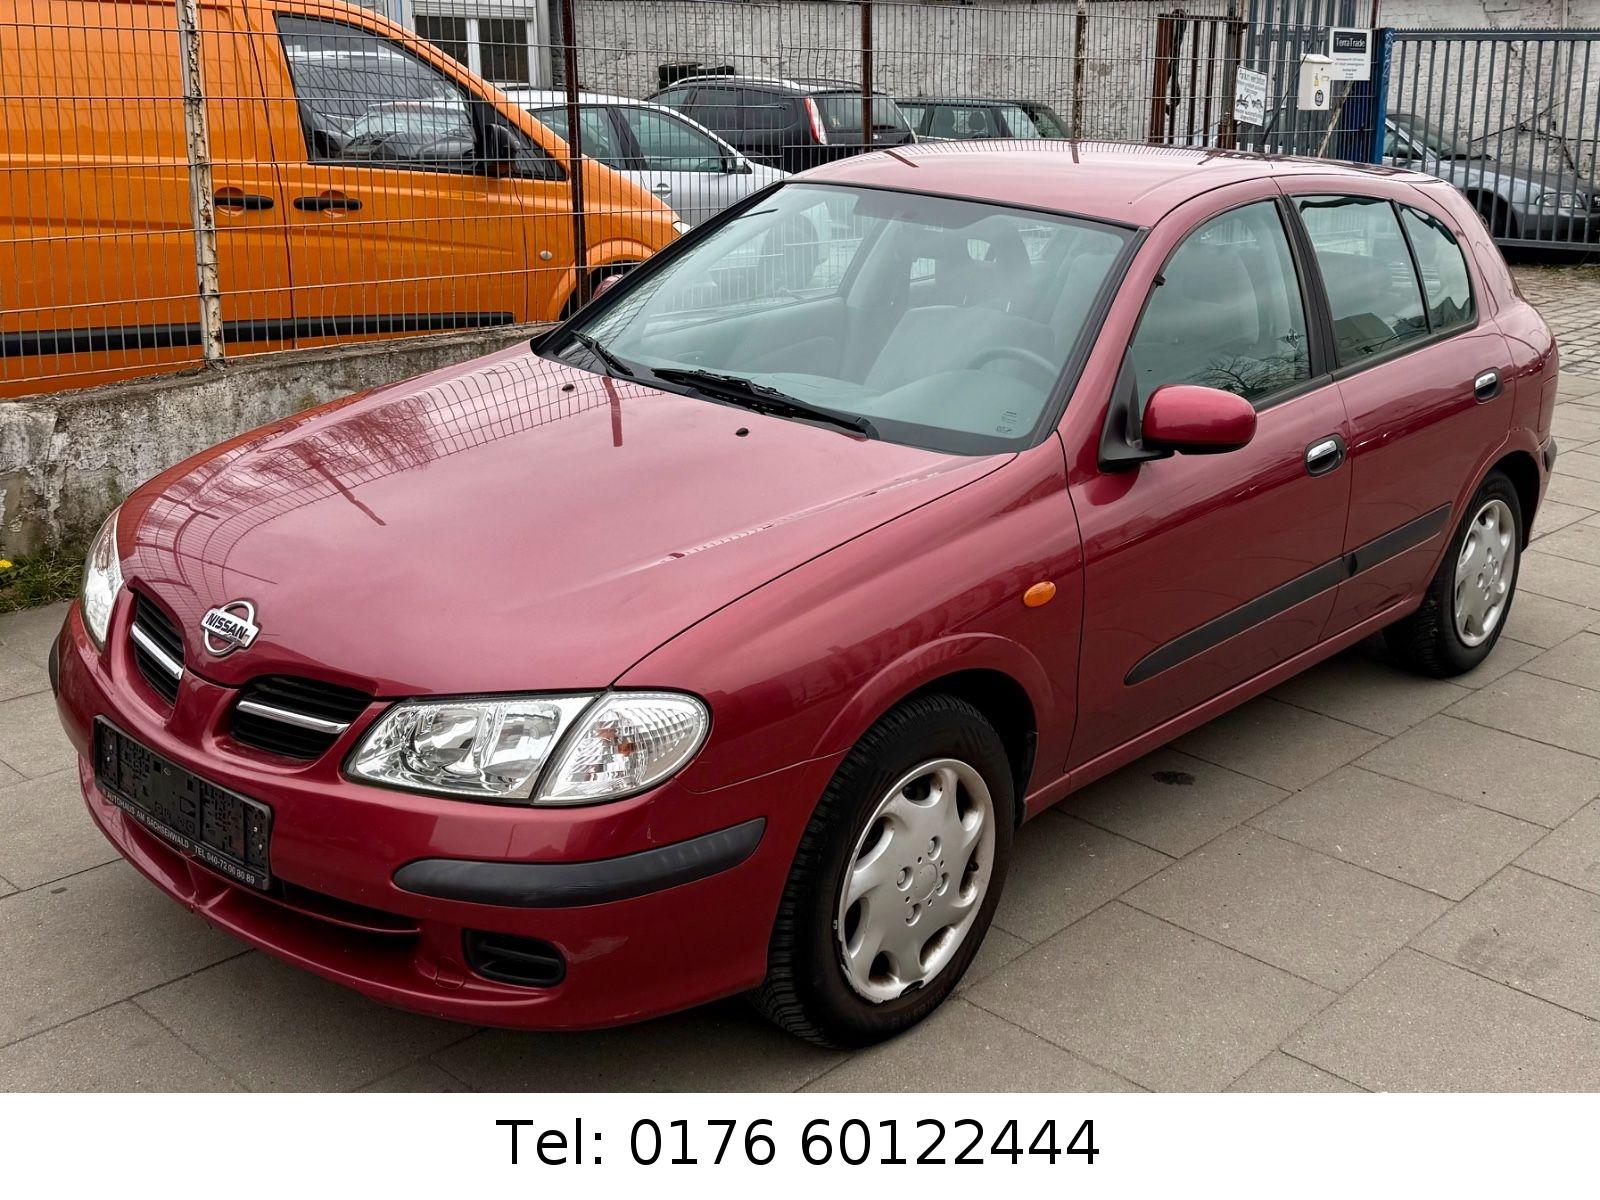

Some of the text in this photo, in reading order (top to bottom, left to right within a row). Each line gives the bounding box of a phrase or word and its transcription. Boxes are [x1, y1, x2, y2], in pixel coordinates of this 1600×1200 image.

[1336, 37, 1366, 48] TerraTrade
[205, 612, 249, 640] NISSAN
[106, 791, 136, 815] AUTOHAUS
[136, 809, 146, 821] AM
[146, 816, 189, 849] SACHSENWALD
[194, 844, 206, 858] TEL
